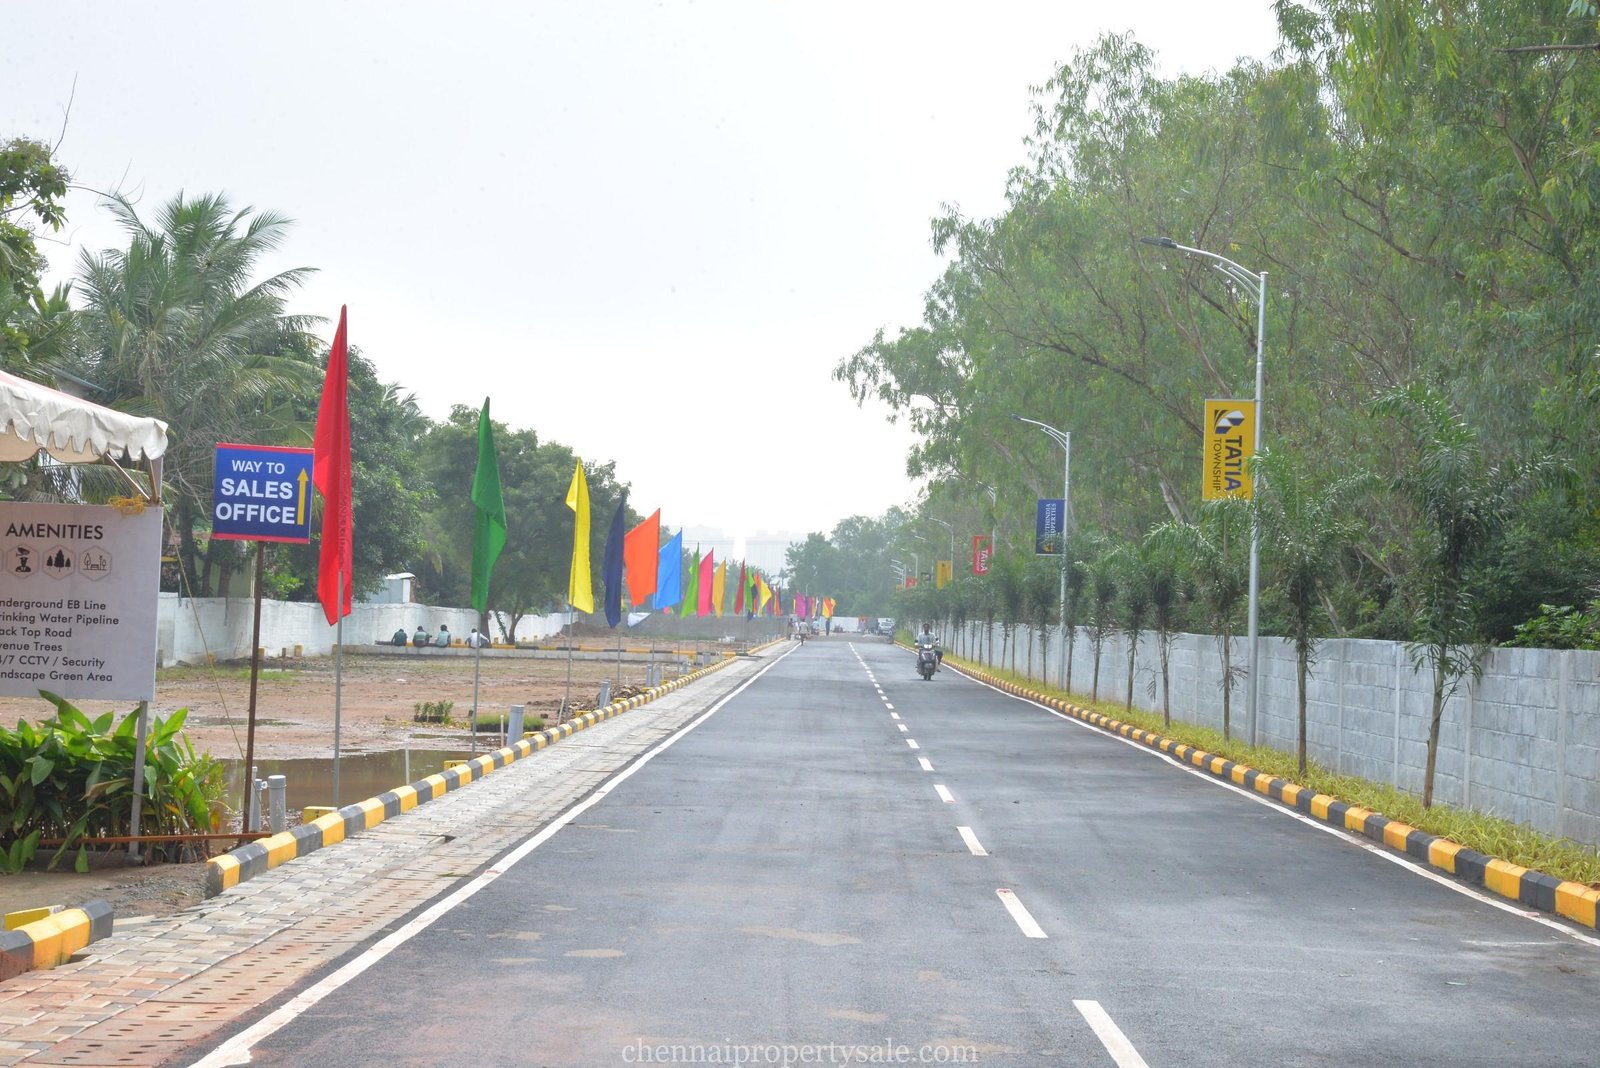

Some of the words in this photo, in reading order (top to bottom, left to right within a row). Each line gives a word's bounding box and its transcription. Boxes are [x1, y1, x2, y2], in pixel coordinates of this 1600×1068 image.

[231, 459, 262, 473] WAY
[266, 461, 285, 475] TO
[1213, 438, 1222, 491] TOWNSHIP
[1224, 435, 1242, 491] TATIA
[220, 478, 293, 500] SALES
[215, 502, 296, 525] OFFICE
[5, 522, 104, 540] AMENITIES
[67, 600, 80, 609] EB
[84, 600, 106, 611] Line
[40, 613, 72, 624] Water
[76, 614, 119, 626] Pipeline
[21, 627, 41, 639] Top
[45, 627, 72, 638] Road
[34, 641, 63, 652] Trees
[0, 654, 15, 665] /7
[19, 655, 50, 665] CCTV
[52, 656, 59, 667] /
[62, 656, 105, 669] Security
[50, 671, 83, 681] Green
[87, 672, 113, 682] Area
